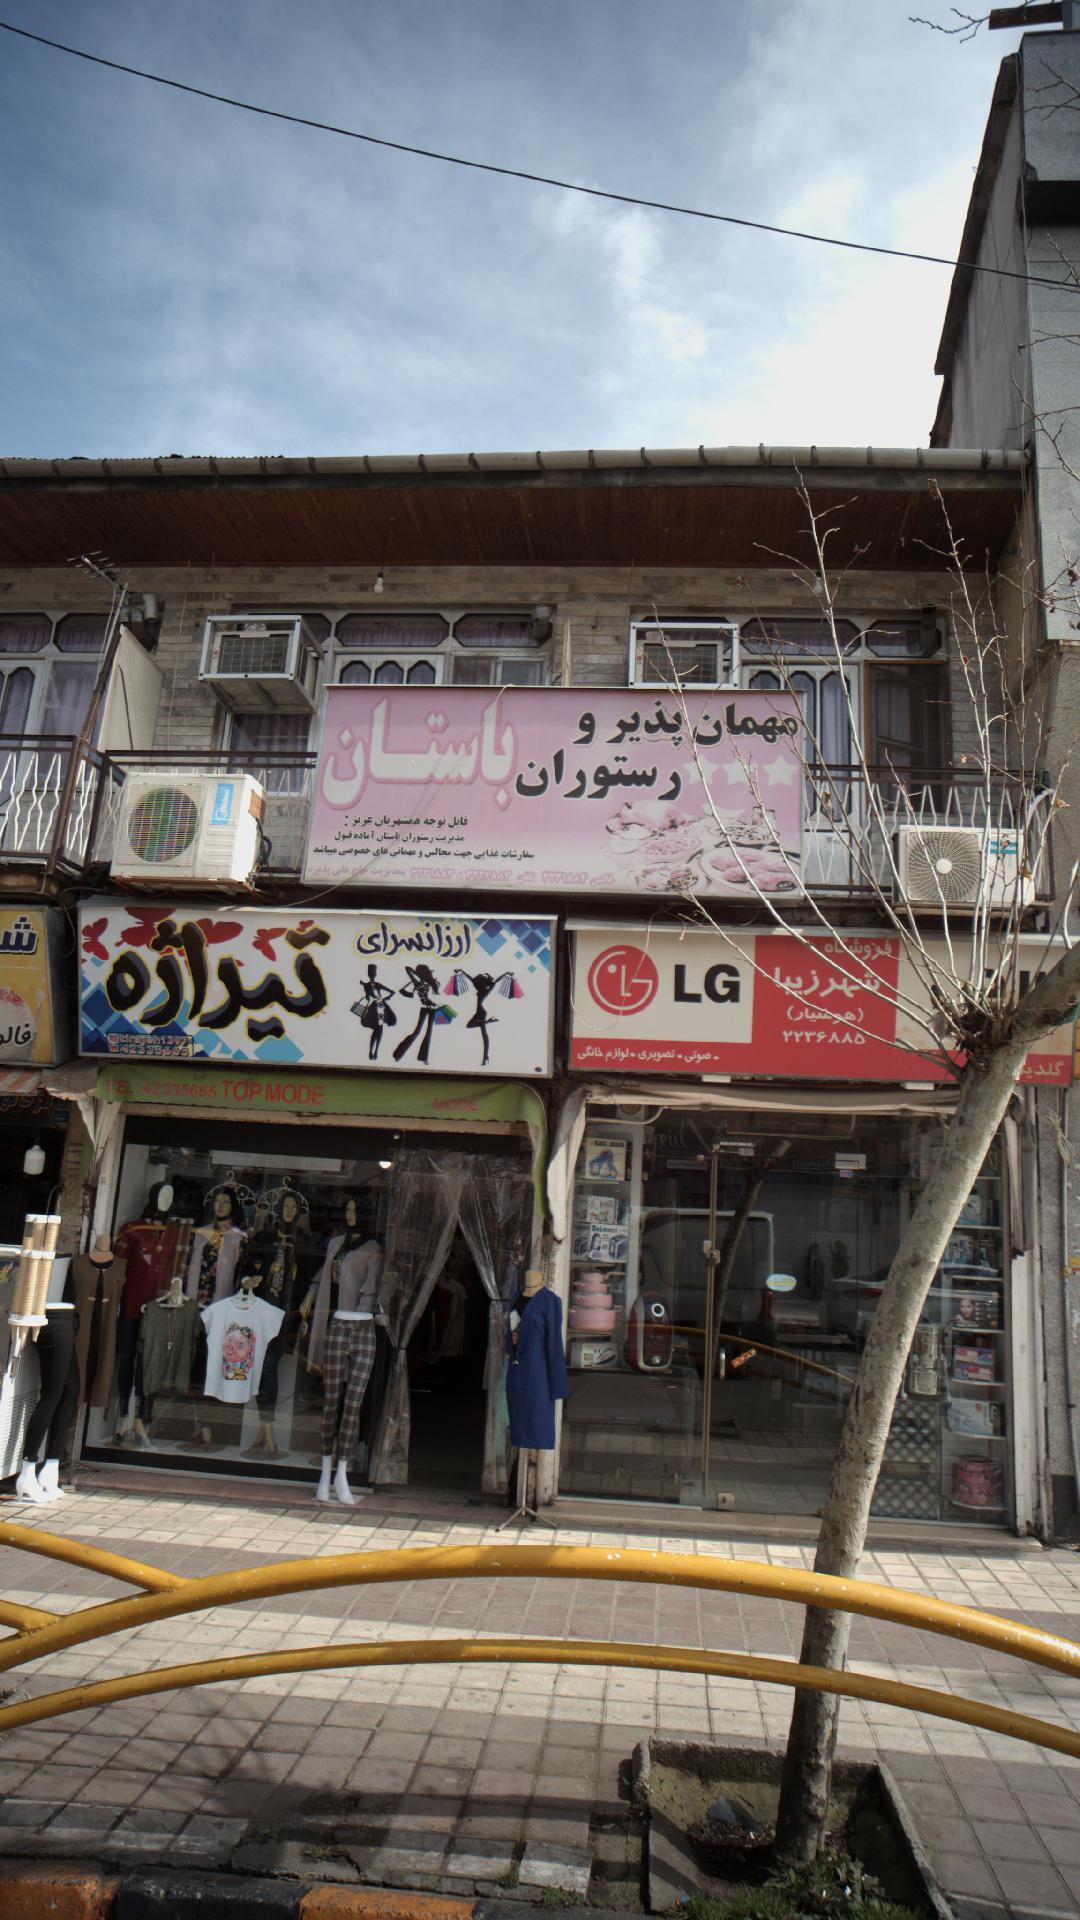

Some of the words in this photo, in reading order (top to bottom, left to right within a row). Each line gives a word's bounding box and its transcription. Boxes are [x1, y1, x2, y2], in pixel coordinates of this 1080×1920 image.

[571, 711, 597, 745] و
[605, 699, 684, 747] پذیر
[693, 701, 799, 746] مهمان
[321, 694, 519, 810] باستان
[514, 747, 682, 801] رستوران
[423, 817, 447, 829] توجه
[376, 831, 401, 842] باستان
[401, 832, 434, 844] رستوران
[356, 921, 472, 958] ارزانسرای
[824, 938, 893, 961] فروشگاه
[106, 918, 331, 1042] تیراژه
[674, 963, 740, 1004] LG
[782, 1030, 866, 1045] ۲۲۳۶۸۸۵
[576, 1046, 603, 1060] خانگی
[605, 1047, 630, 1063] لوازم
[637, 1049, 676, 1062] تصویری
[684, 1050, 712, 1063] صوتی
[221, 1079, 263, 1103] TOP
[264, 1081, 325, 1105] MODE
